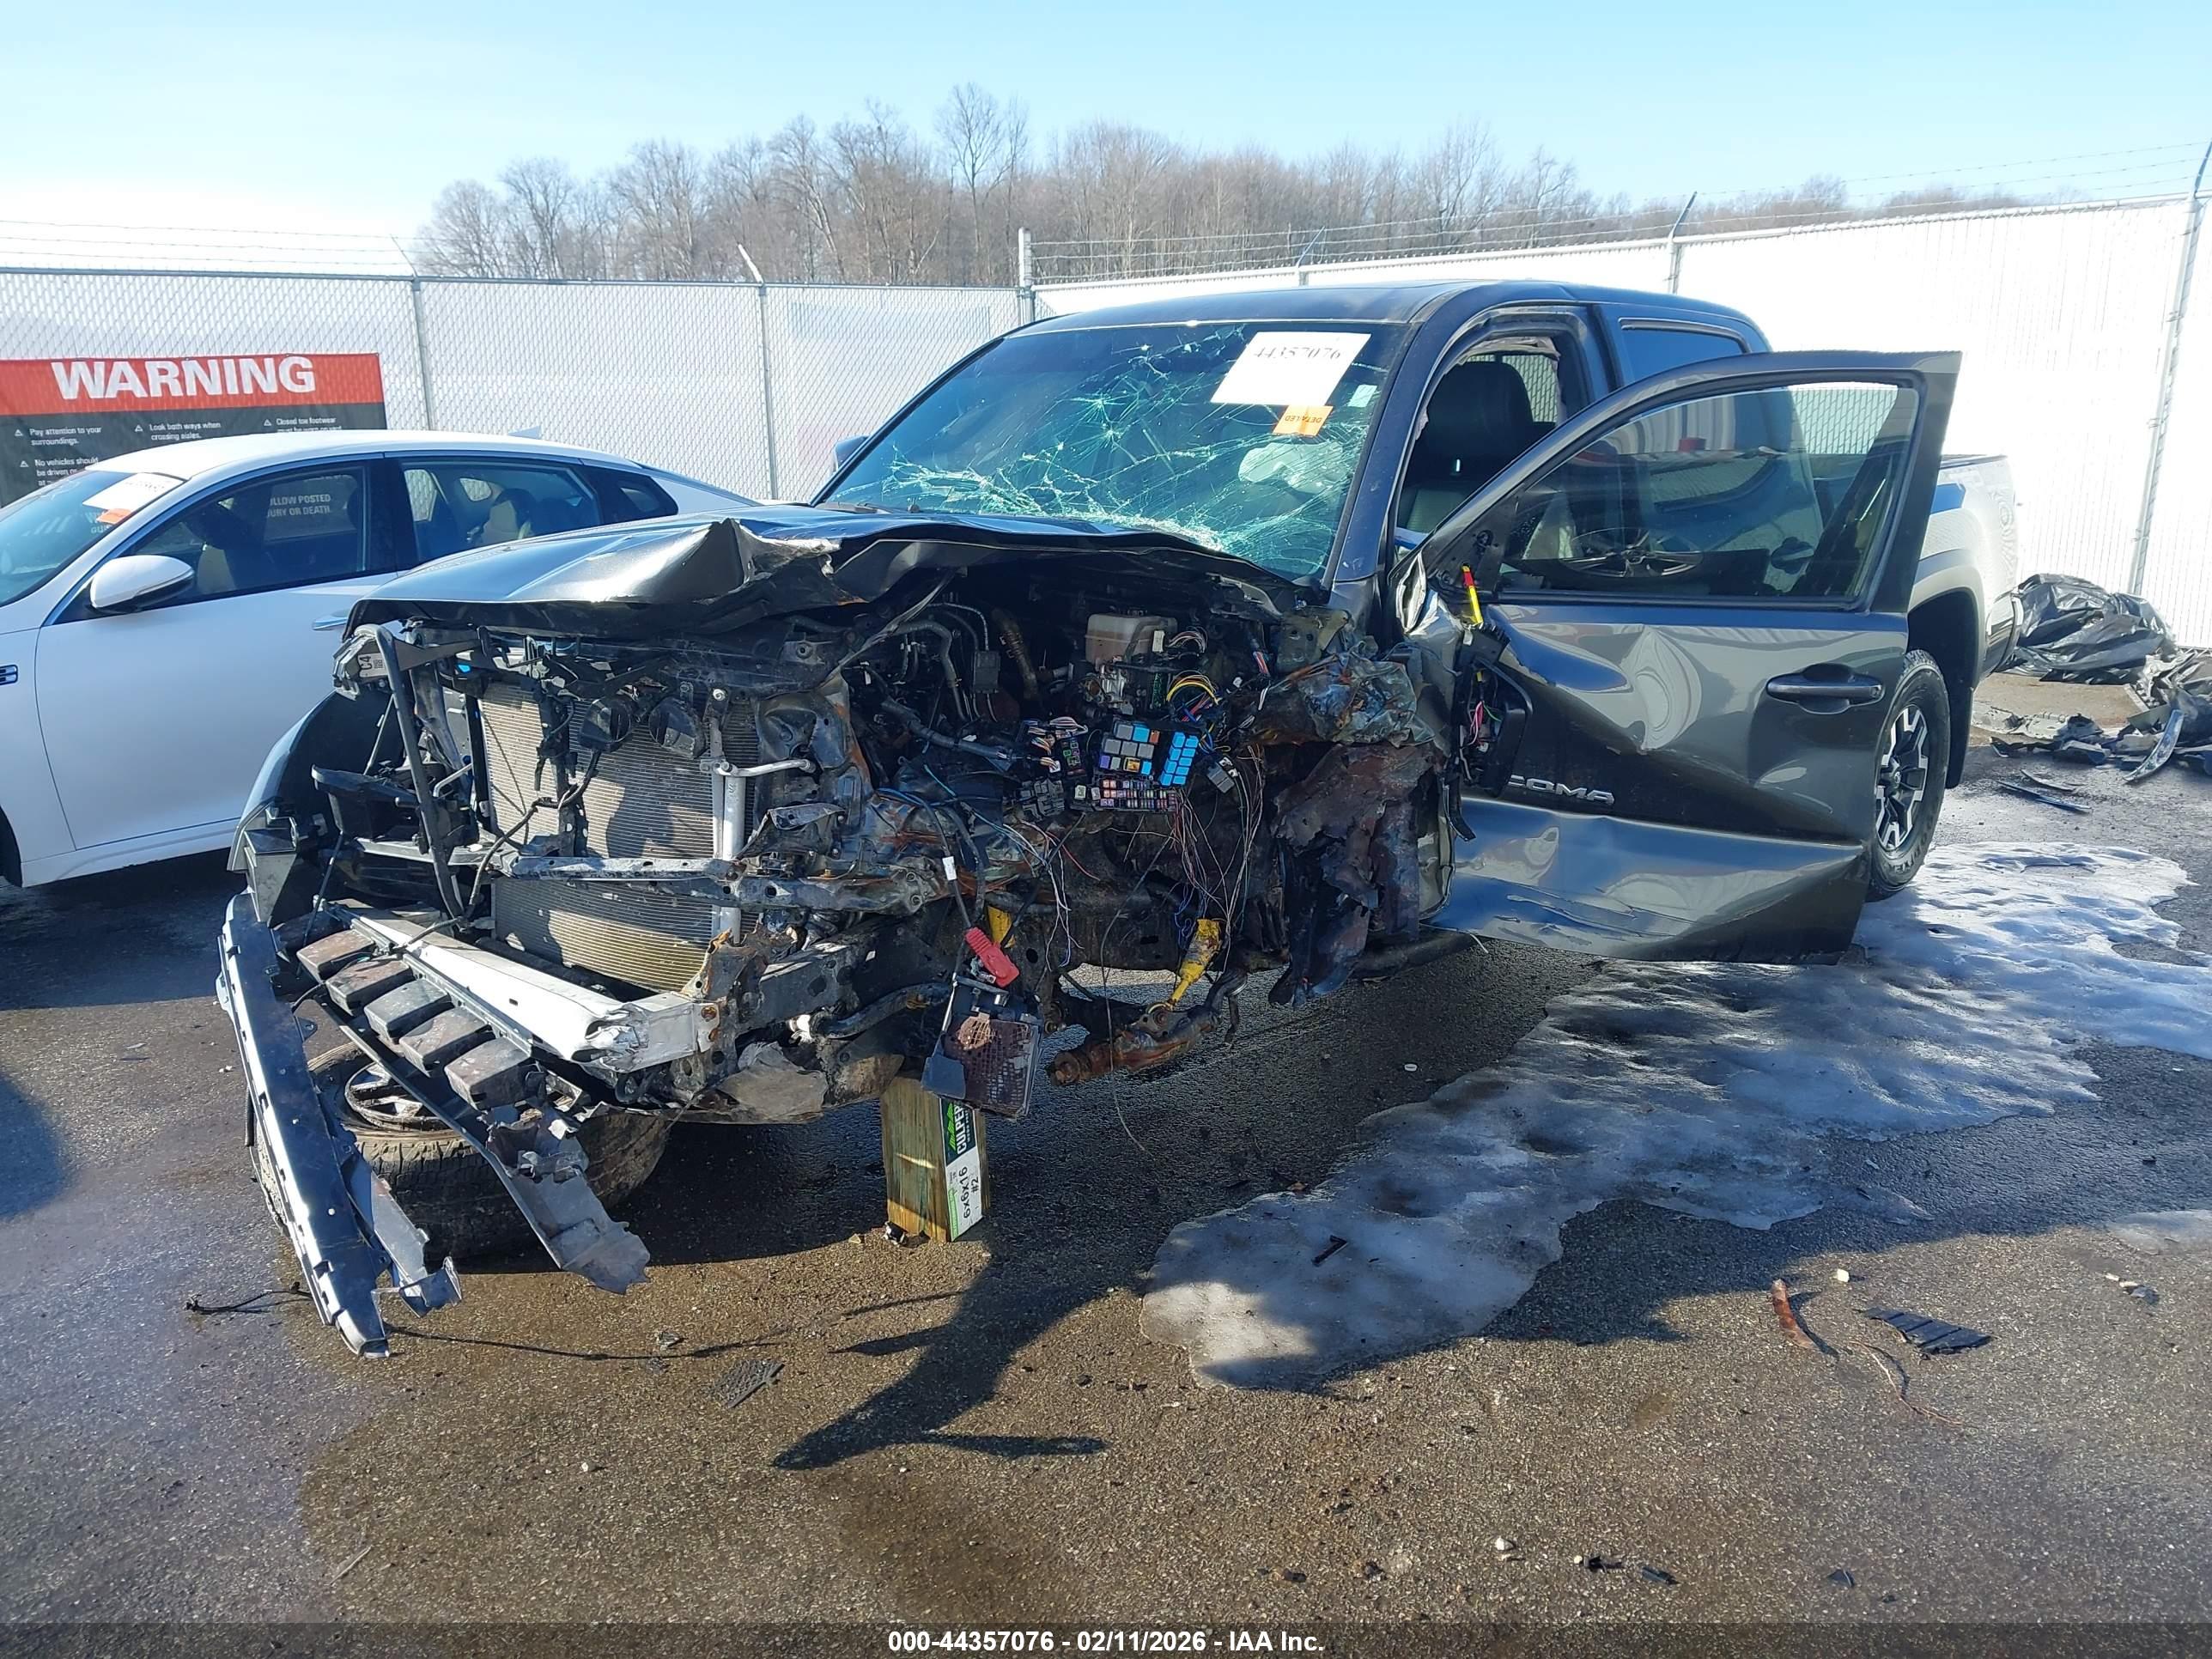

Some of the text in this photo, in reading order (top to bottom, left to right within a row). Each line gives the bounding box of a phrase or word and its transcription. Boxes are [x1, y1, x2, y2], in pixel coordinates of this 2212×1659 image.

[51, 356, 316, 400] WARNING
[29, 428, 44, 436] Pay
[46, 427, 76, 435] attention
[87, 427, 102, 435] your
[149, 423, 166, 432] Look
[167, 422, 183, 431] both
[31, 437, 79, 446] surroundings.
[298, 494, 331, 504] POSTED
[289, 506, 301, 516] OR
[302, 505, 331, 515] DEATH
[359, 655, 373, 670] C4
[953, 1103, 967, 1155] CULPEP
[970, 1176, 979, 1193] #2
[958, 1166, 971, 1218] 6x6x16
